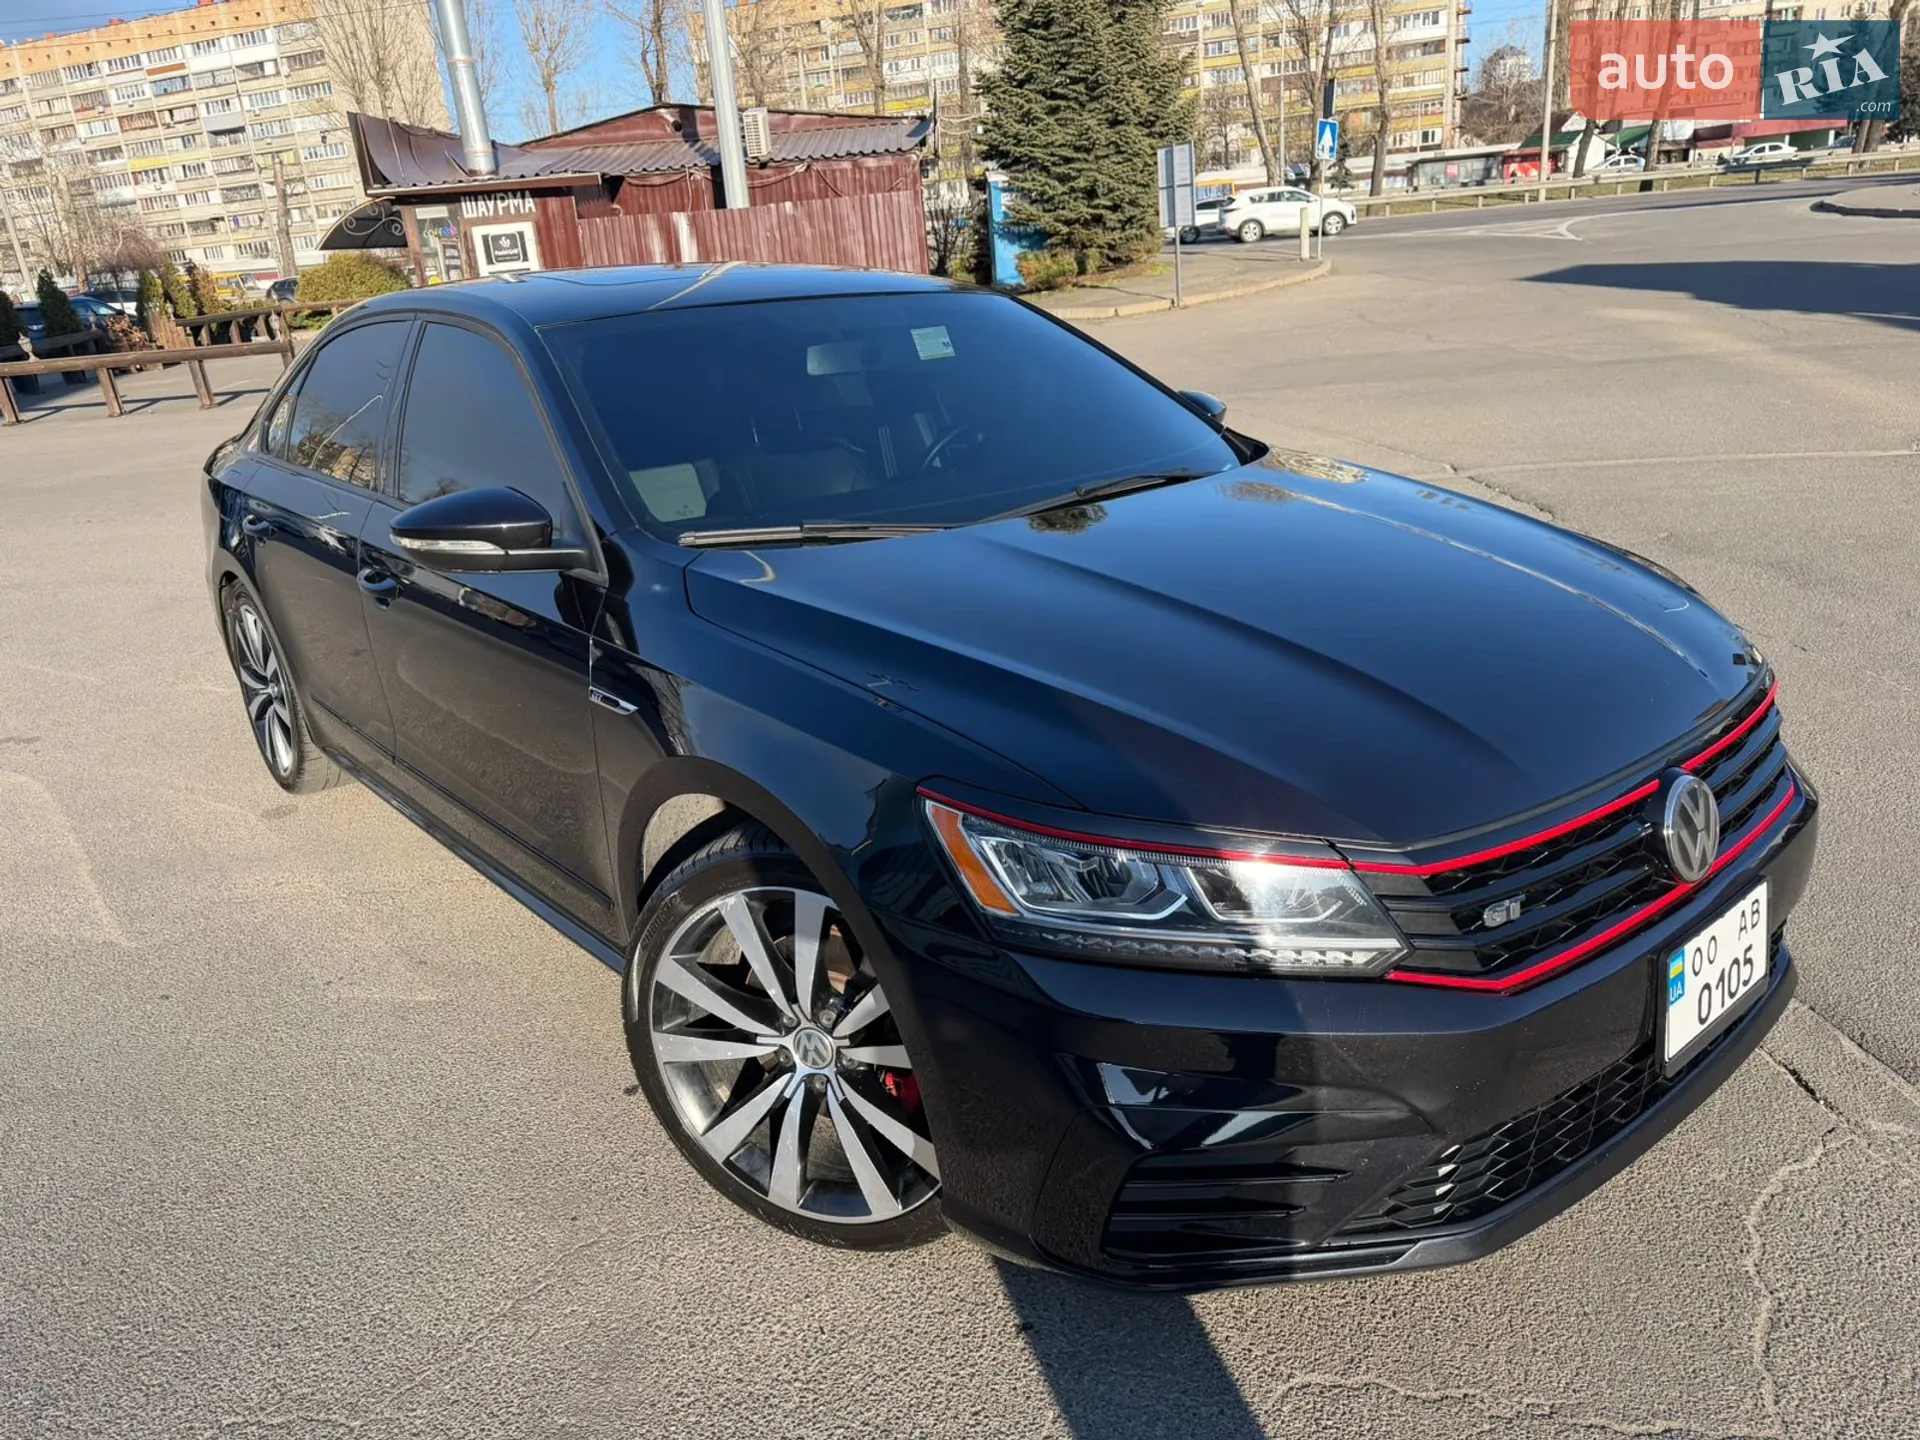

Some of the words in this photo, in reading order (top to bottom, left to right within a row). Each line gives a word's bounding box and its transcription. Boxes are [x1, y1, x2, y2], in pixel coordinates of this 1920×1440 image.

[460, 190, 537, 219] ШАУРМА
[1738, 898, 1761, 941] AB
[1669, 984, 1683, 1001] UA
[1697, 943, 1754, 1026] 0105
